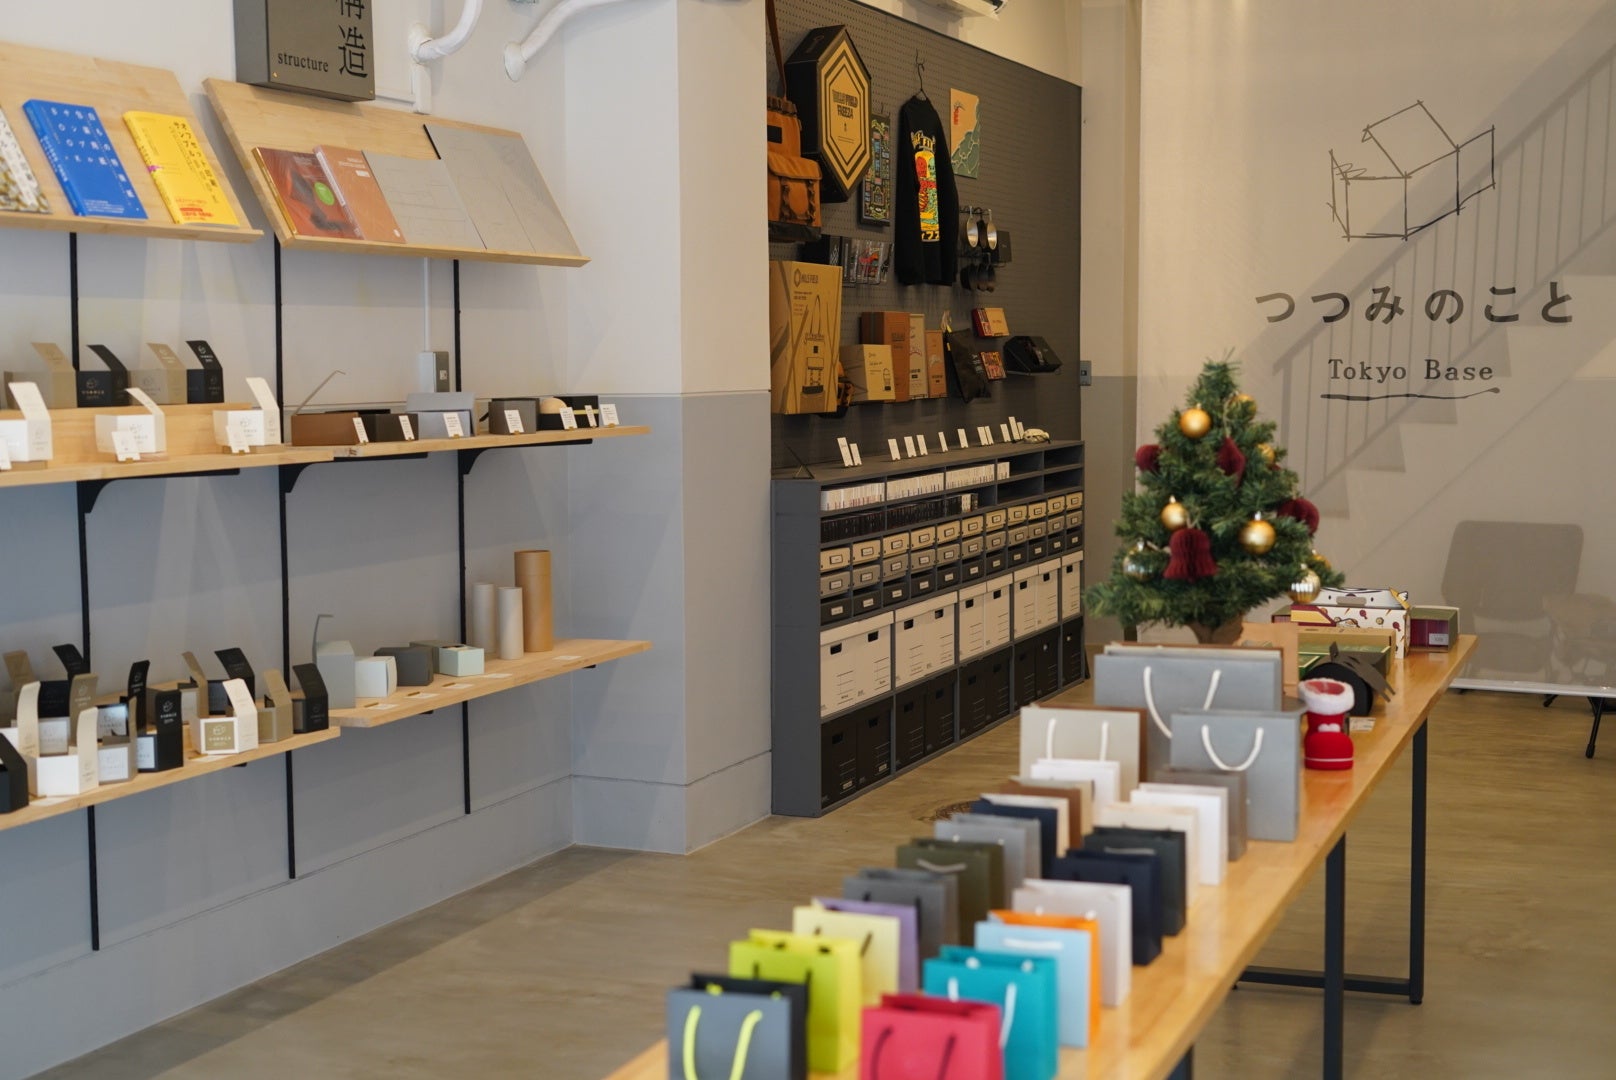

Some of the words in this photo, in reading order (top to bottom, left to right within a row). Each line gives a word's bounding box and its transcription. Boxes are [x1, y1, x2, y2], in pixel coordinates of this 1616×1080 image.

[277, 52, 329, 73] structure
[1255, 281, 1573, 325] つつみのこと
[1328, 359, 1407, 384] Tokyo
[1424, 359, 1493, 381] Base
